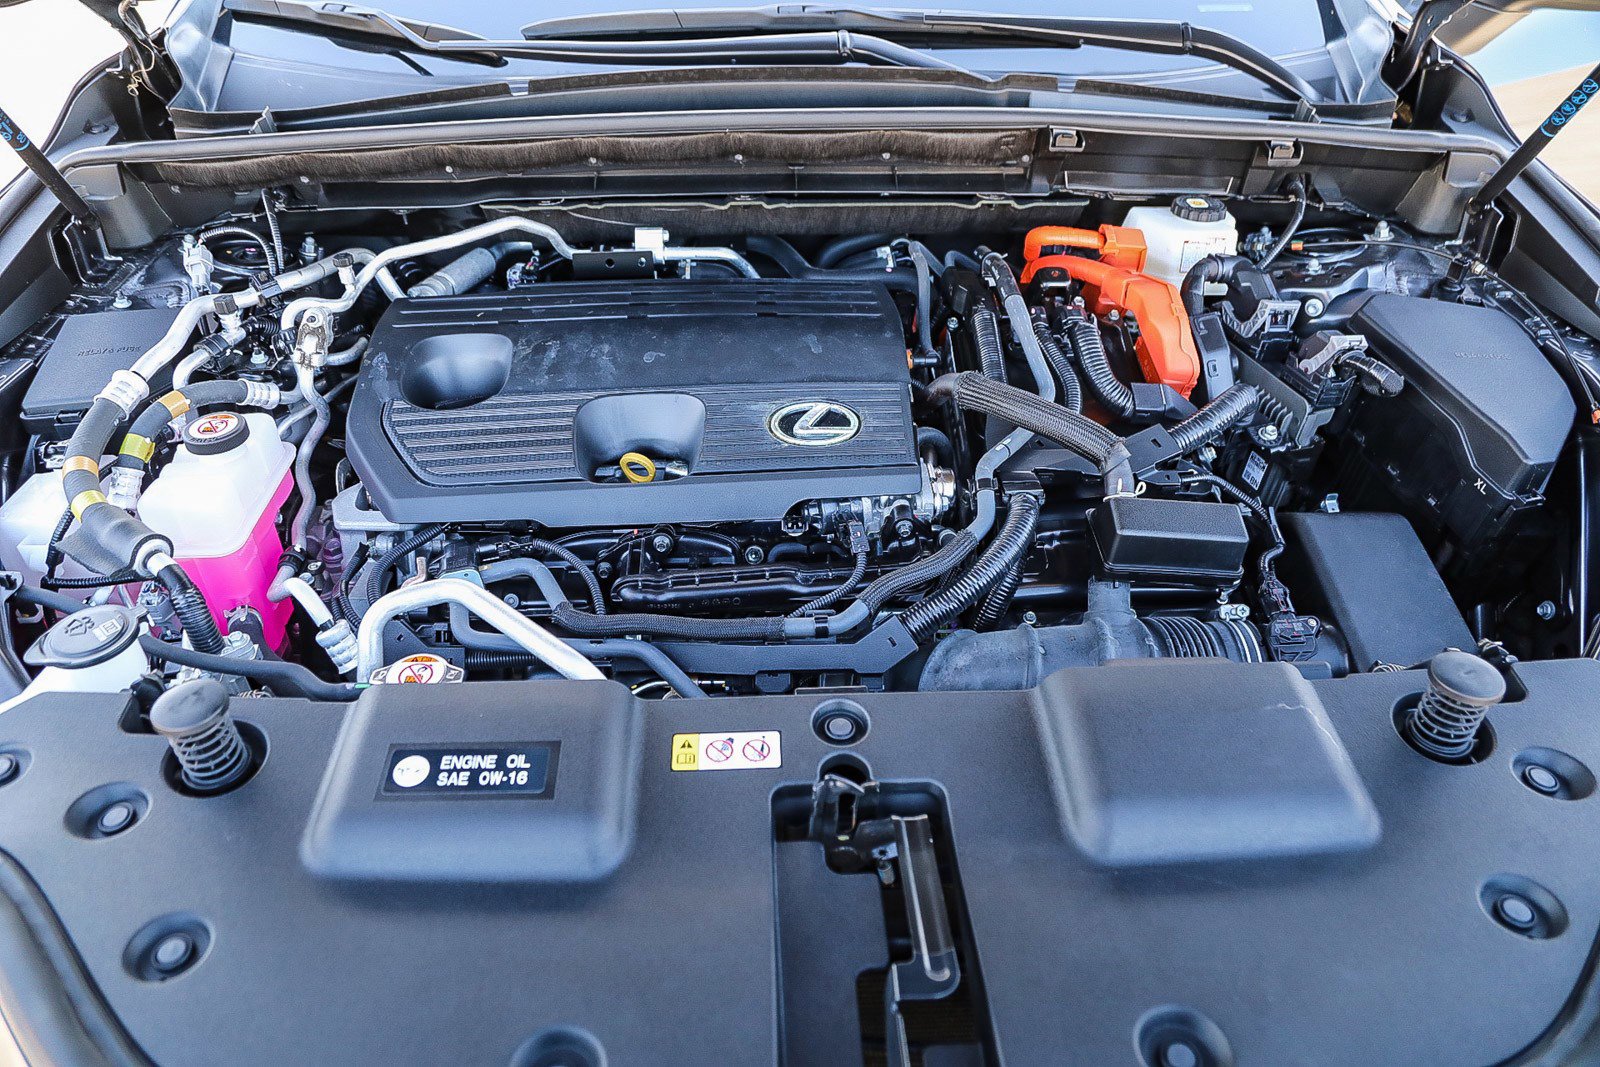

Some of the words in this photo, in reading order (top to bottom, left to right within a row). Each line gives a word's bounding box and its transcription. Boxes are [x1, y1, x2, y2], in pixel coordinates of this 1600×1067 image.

[1473, 477, 1487, 496] XL
[440, 754, 498, 770] ENGINE
[506, 754, 531, 769] OIL
[436, 771, 470, 786] SAE
